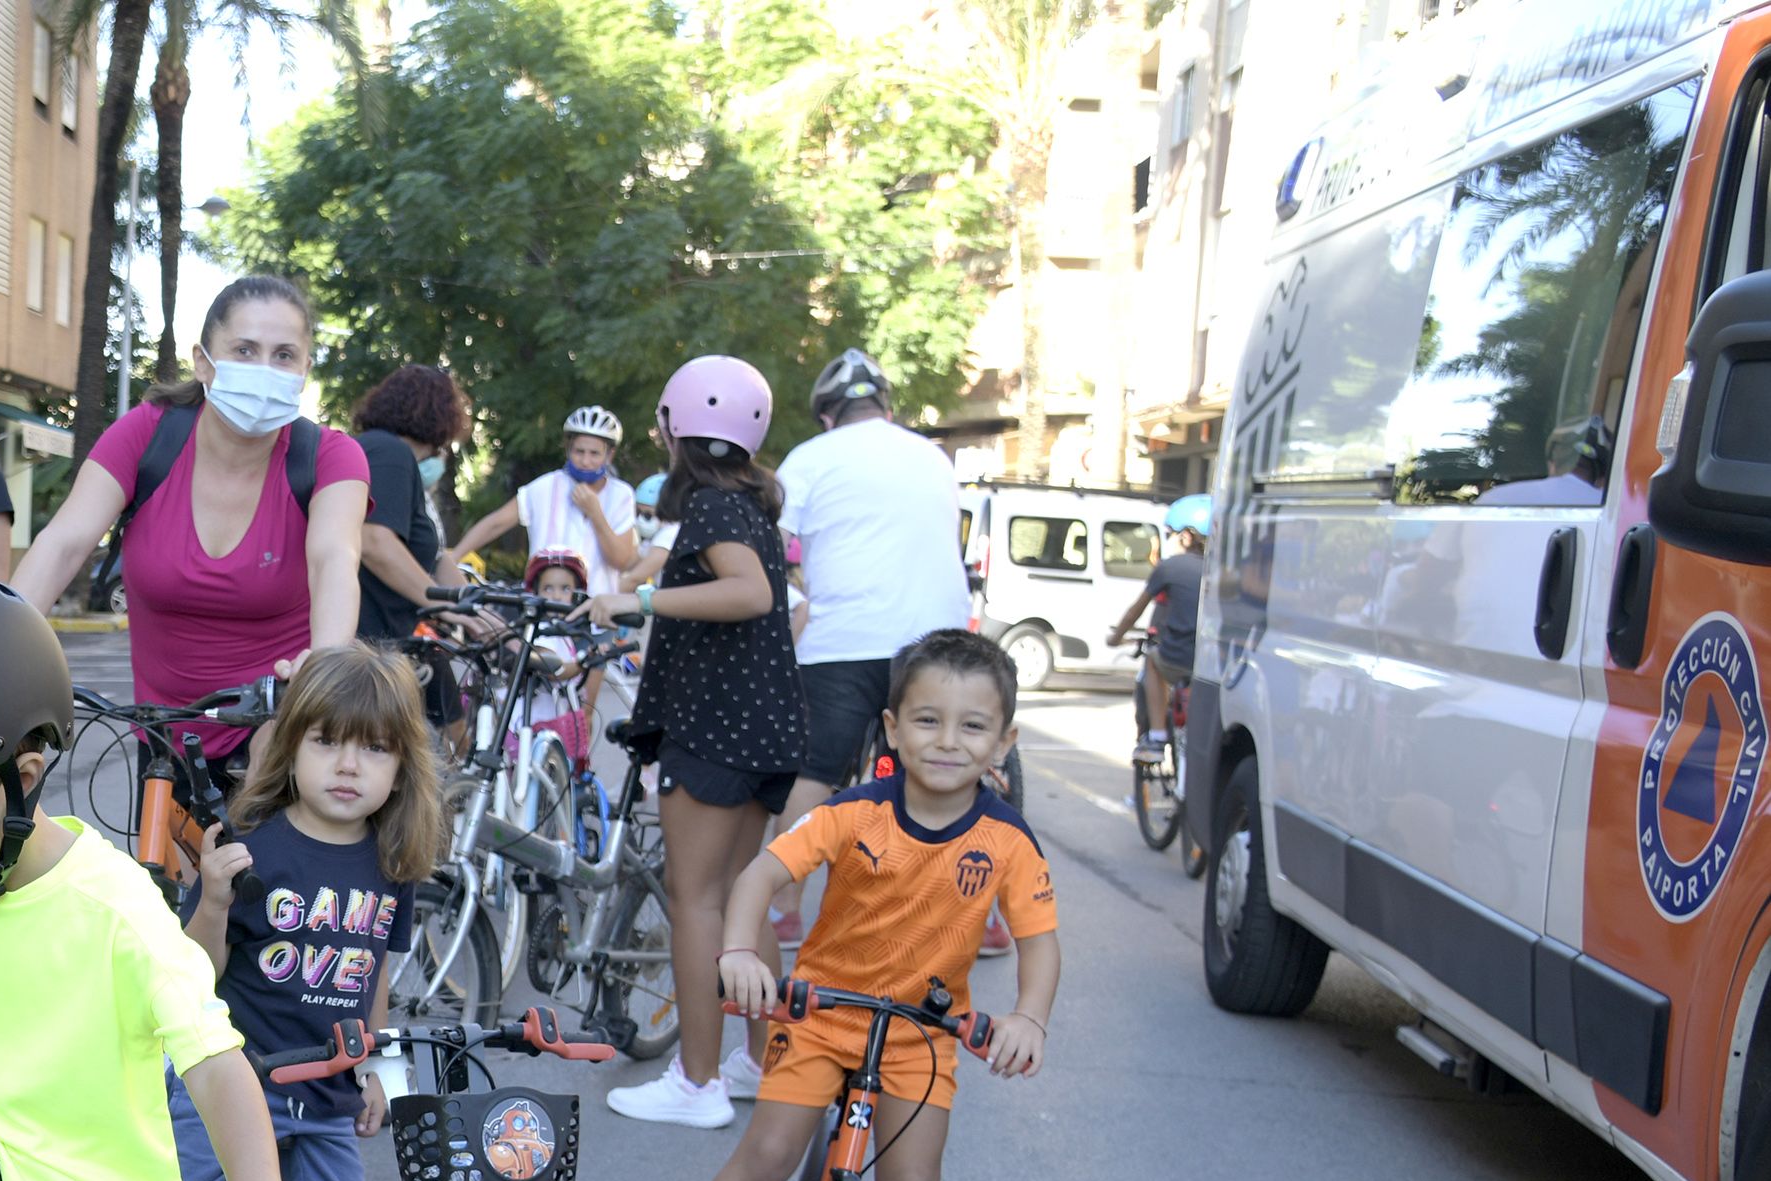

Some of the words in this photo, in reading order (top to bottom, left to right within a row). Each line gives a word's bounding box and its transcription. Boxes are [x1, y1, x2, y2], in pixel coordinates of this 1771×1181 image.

[1644, 636, 1742, 789] PROTECCIÓN
[1732, 690, 1761, 804] CIVIL
[1641, 826, 1727, 908] PAIPORTA
[265, 886, 398, 940] GAME
[258, 940, 376, 993] OVER
[300, 993, 326, 1005] PLAY
[327, 996, 359, 1008] REPEAT
